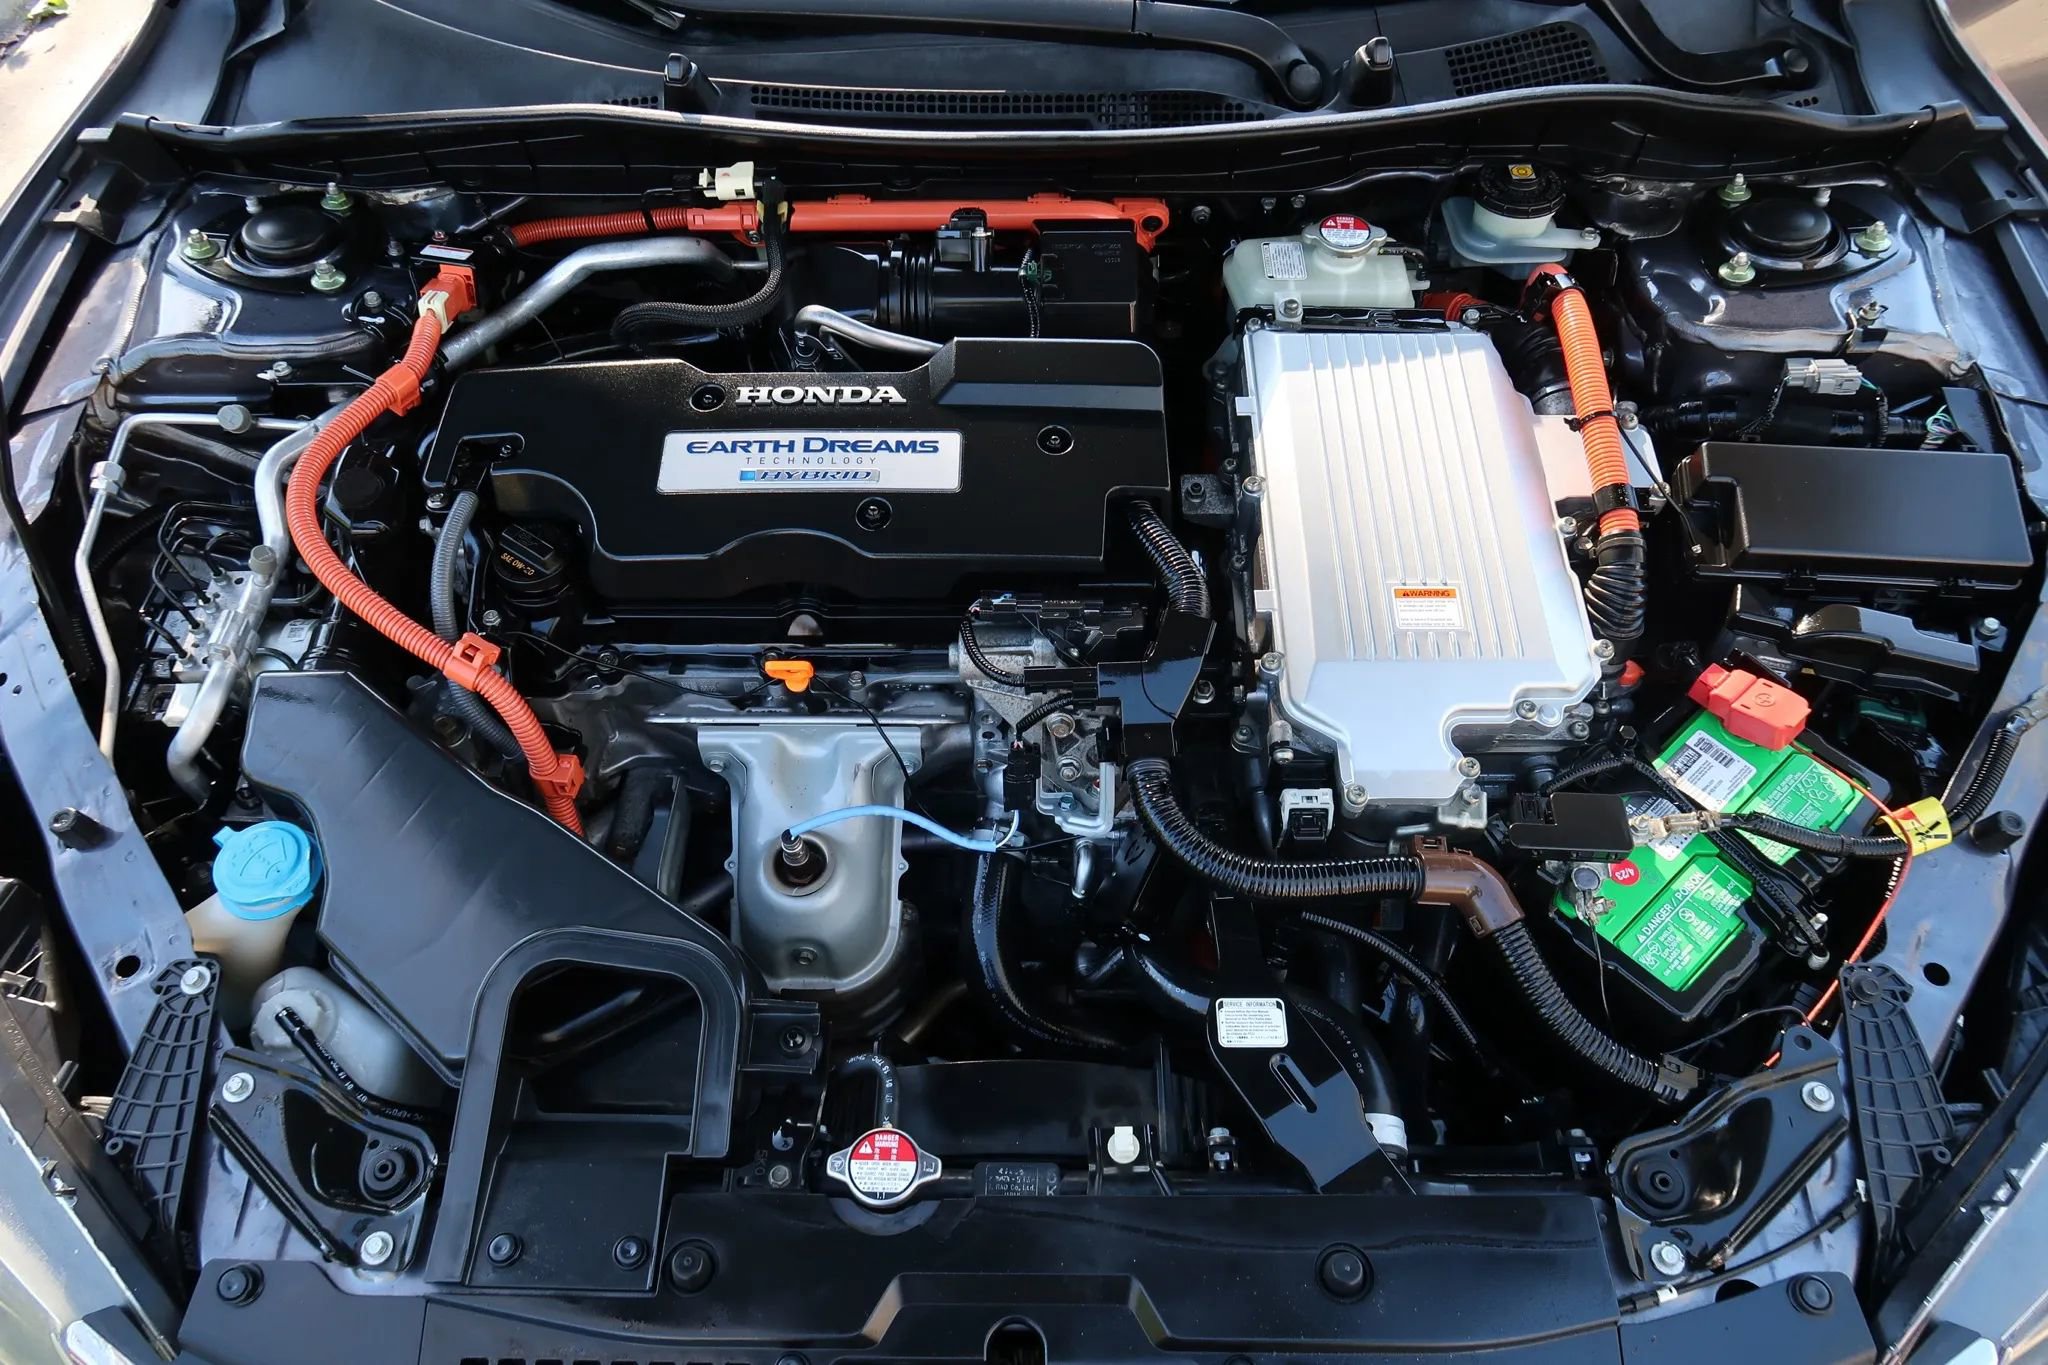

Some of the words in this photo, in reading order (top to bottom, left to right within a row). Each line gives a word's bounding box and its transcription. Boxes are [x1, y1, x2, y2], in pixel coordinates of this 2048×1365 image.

[735, 386, 906, 405] HONDA
[686, 440, 795, 454] EARTH
[803, 437, 940, 454] DREAMS
[760, 470, 873, 480] HYBRID
[501, 552, 514, 564] SAE
[512, 560, 535, 576] 0W-20
[1615, 867, 1635, 880] 4/23
[1641, 902, 1673, 935] DANGER
[1675, 871, 1704, 900] POISON
